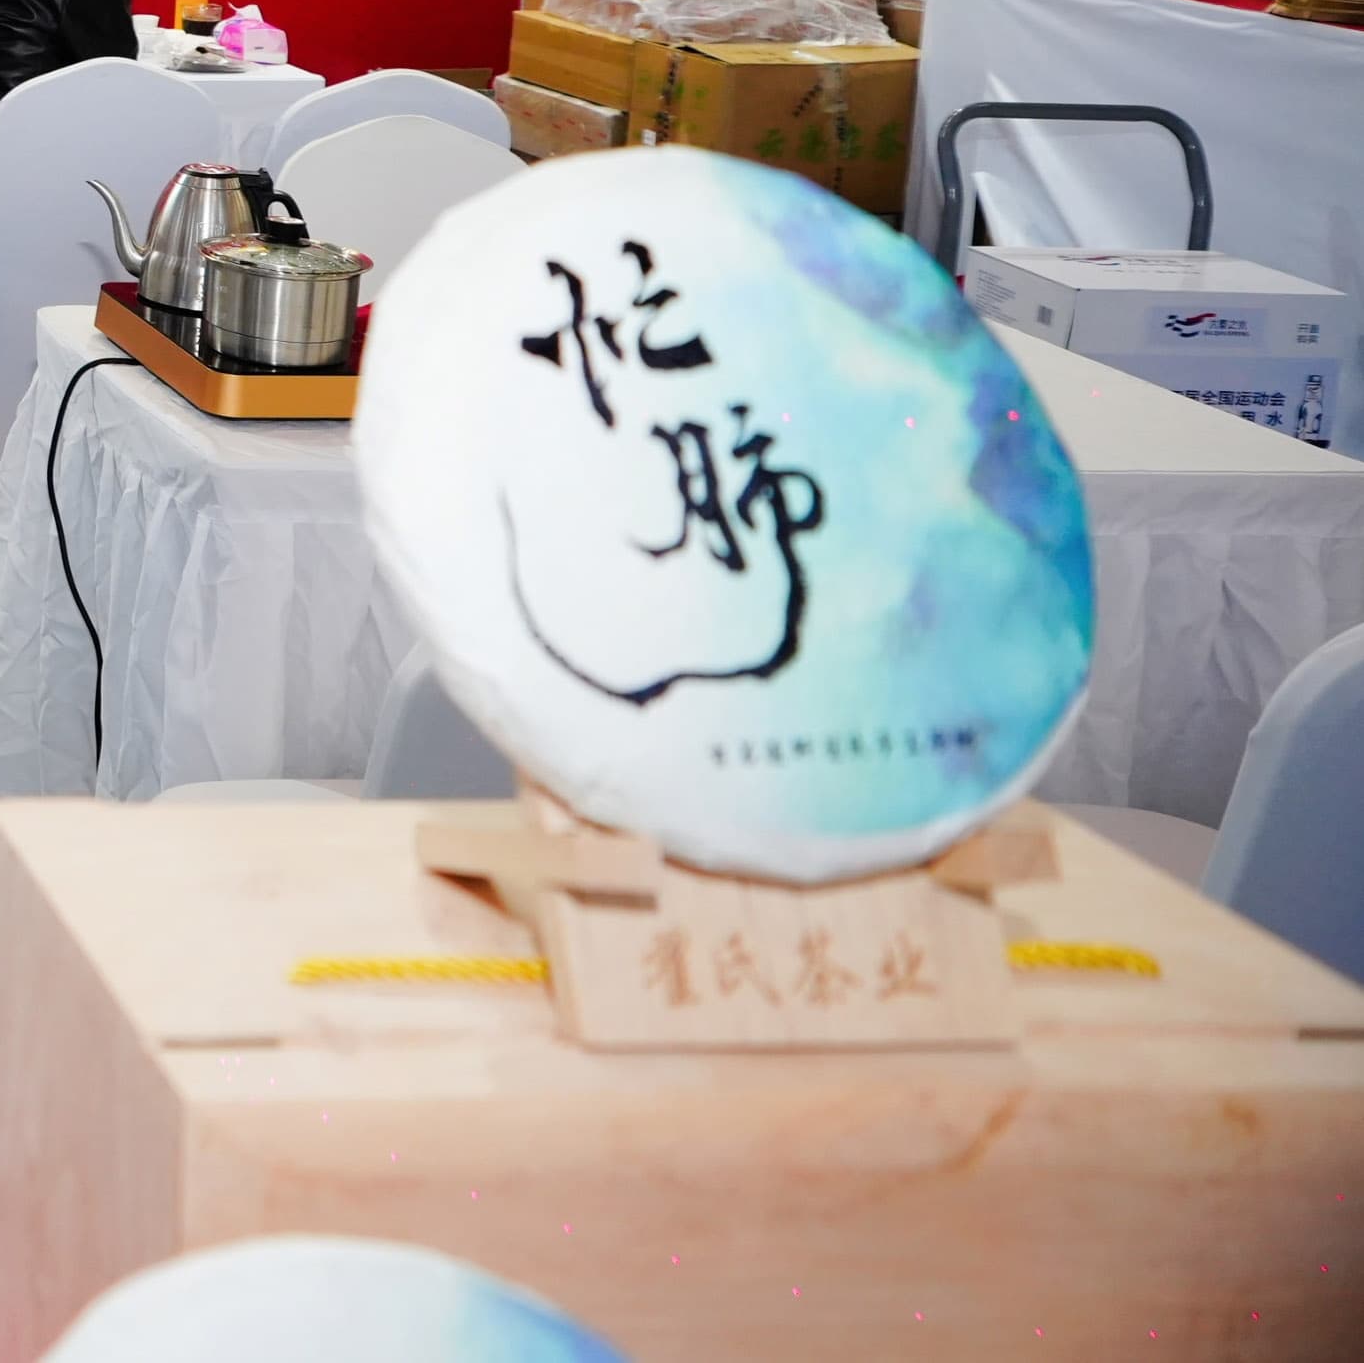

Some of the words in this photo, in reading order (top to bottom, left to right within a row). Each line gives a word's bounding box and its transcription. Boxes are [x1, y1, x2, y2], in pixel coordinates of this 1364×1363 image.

[1174, 390, 1286, 407] 届全国运动会
